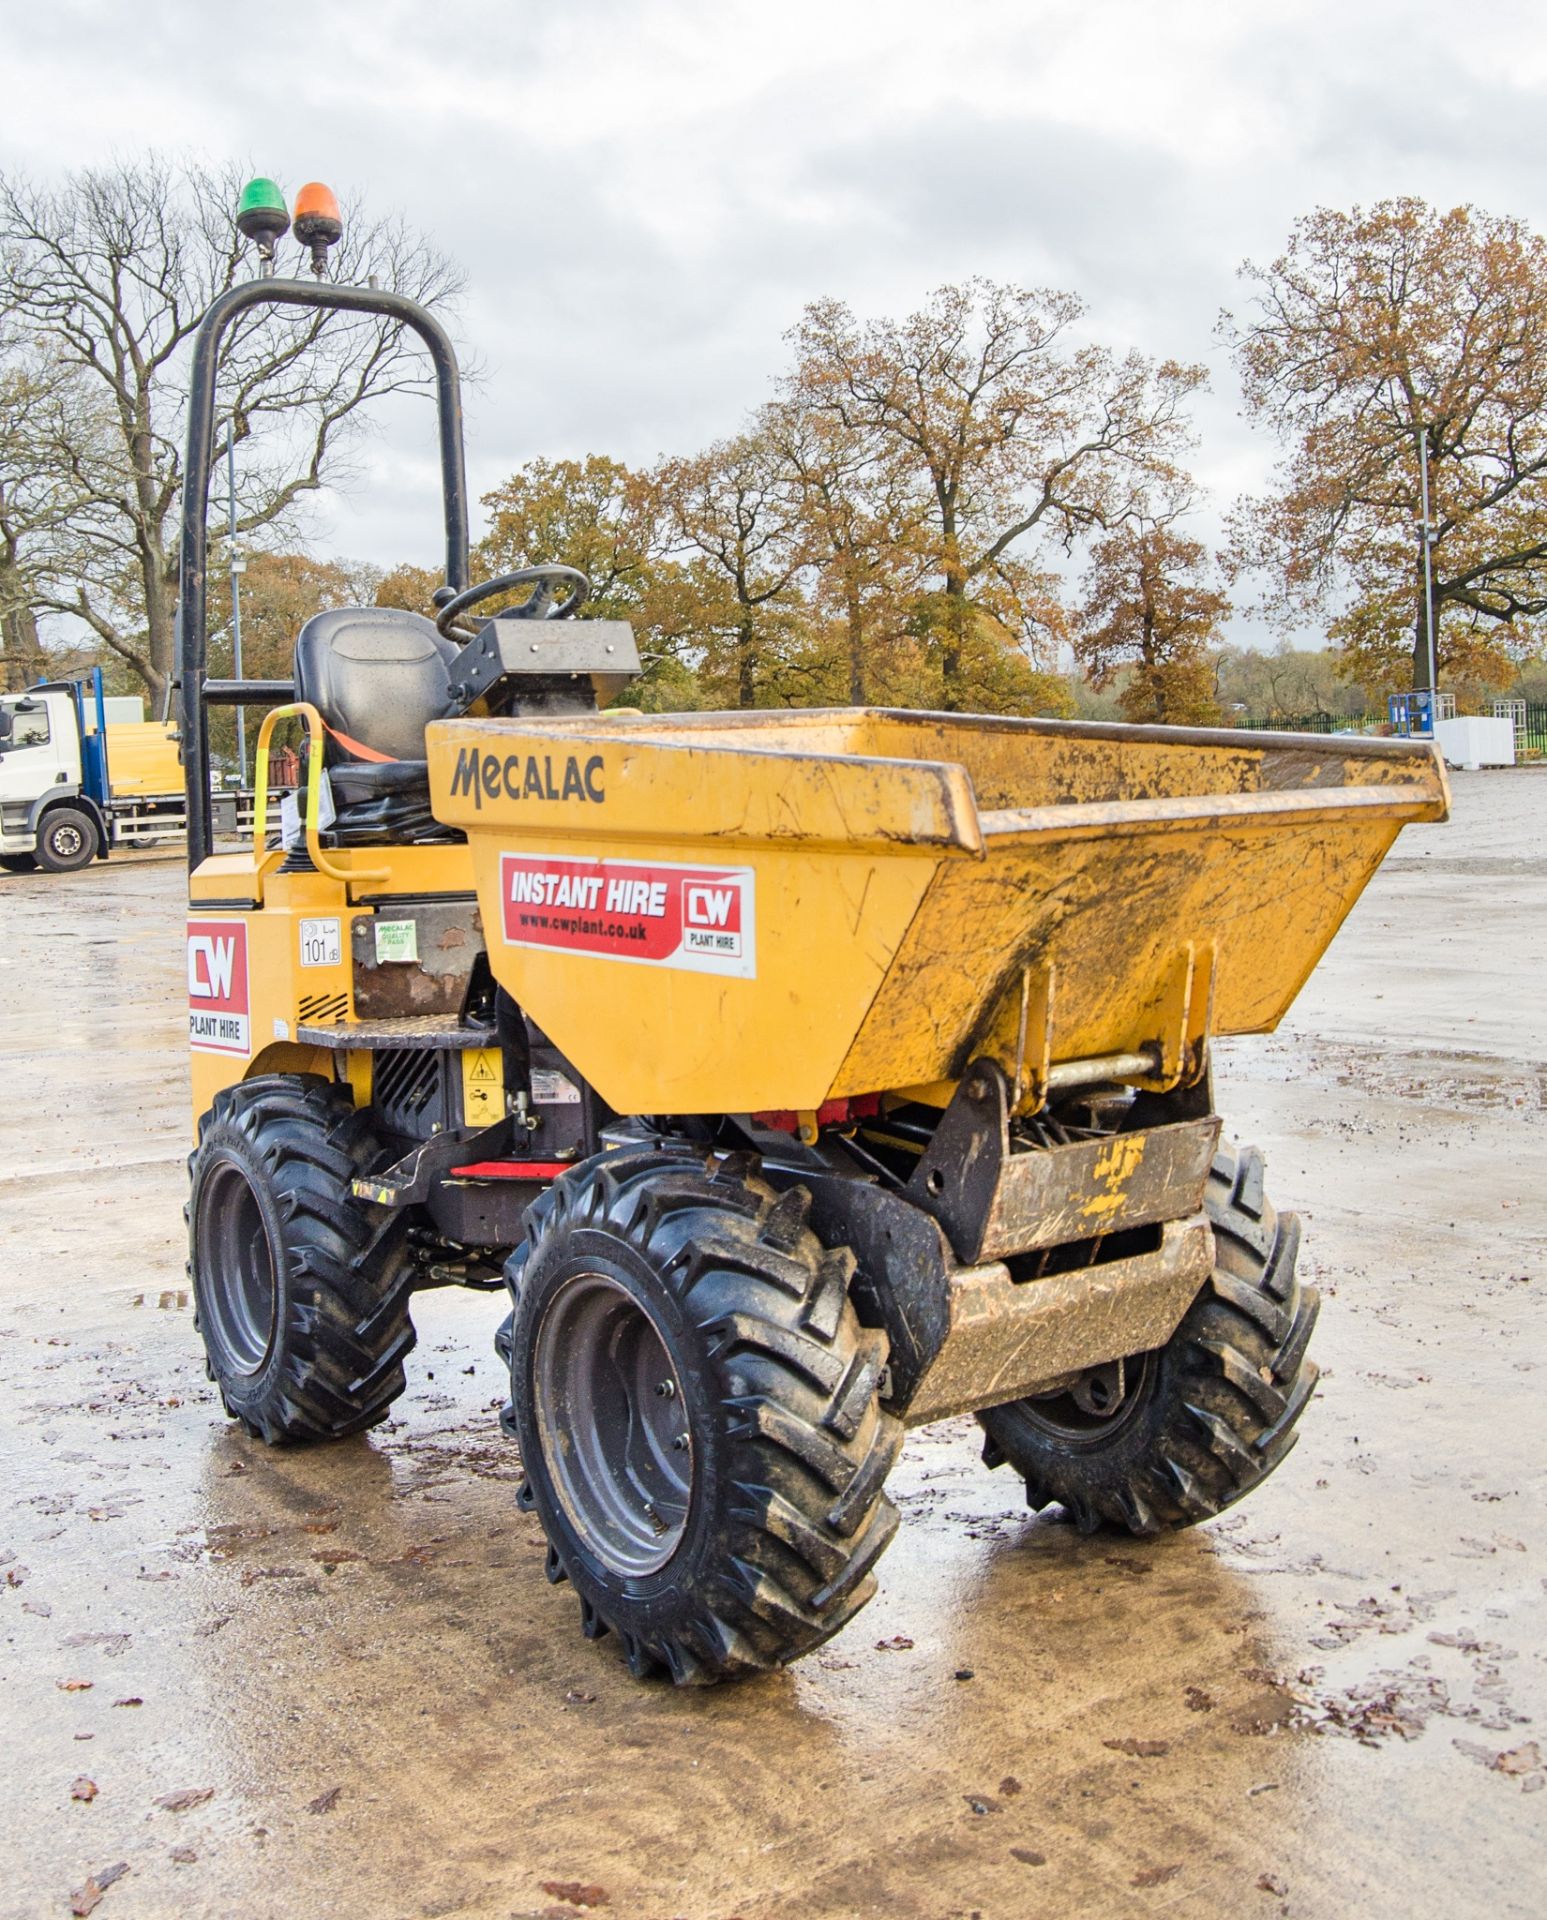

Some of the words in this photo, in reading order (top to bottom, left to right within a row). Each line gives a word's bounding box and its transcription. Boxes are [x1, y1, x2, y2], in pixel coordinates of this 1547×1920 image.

[511, 871, 604, 911] INSTANT
[605, 878, 668, 918] HIRE
[688, 887, 733, 926] CW
[519, 912, 647, 941] www.cwplant.co.uk
[689, 932, 714, 947] PLANT
[716, 935, 735, 950] HIRE
[305, 938, 326, 962] 101
[187, 935, 236, 1001] CW
[189, 1015, 217, 1037] PLANT
[219, 1018, 240, 1041] HIRE
